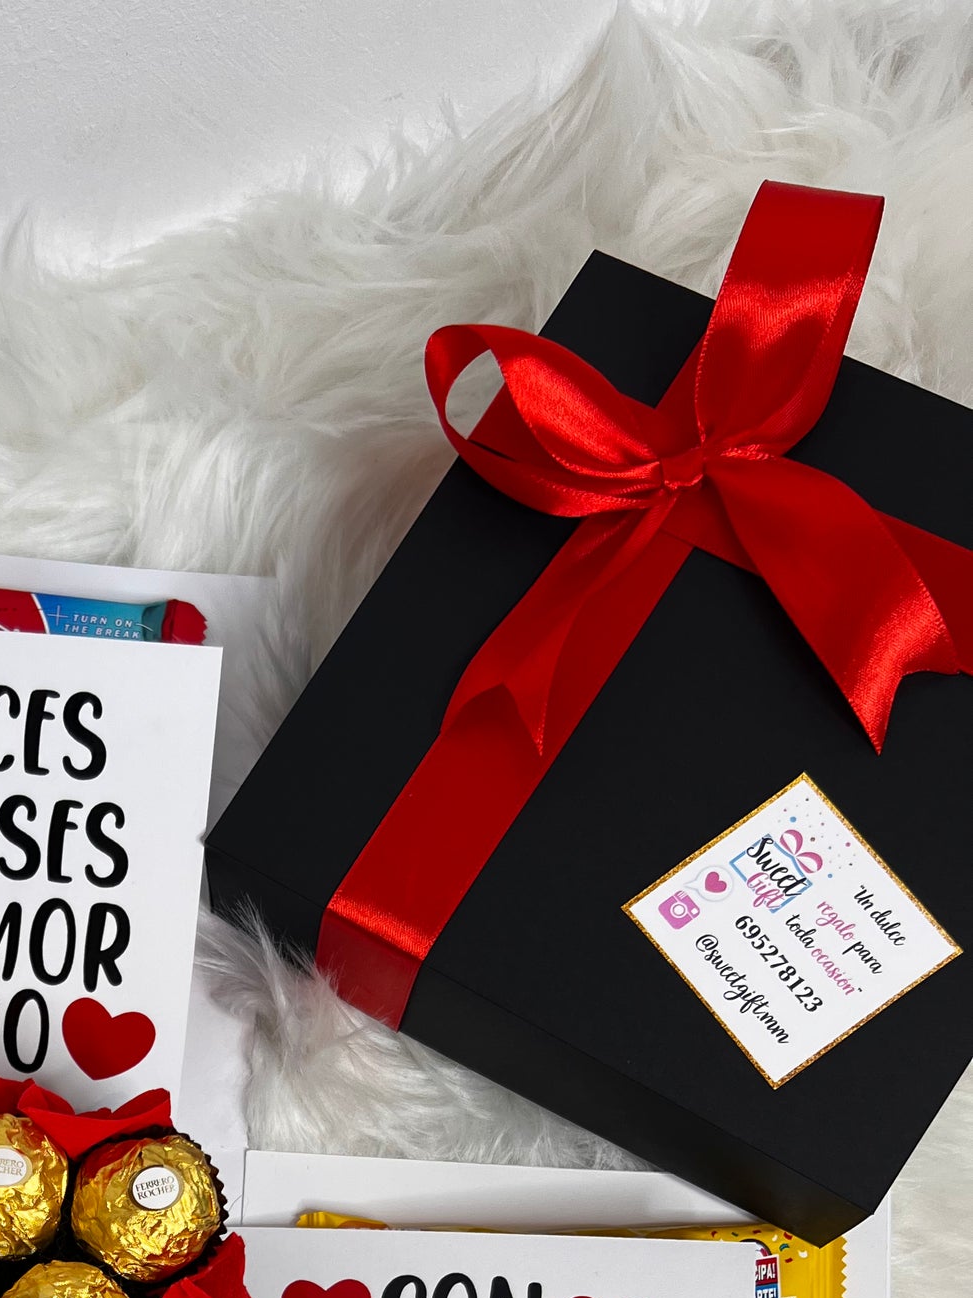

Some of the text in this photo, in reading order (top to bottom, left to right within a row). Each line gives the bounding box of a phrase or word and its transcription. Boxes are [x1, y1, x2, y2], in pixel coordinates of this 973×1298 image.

[64, 624, 140, 639] THE BREAK
[73, 614, 133, 628] TURN ON
[746, 837, 807, 897] Sweet
[746, 872, 785, 908] Gift
[785, 914, 817, 949] toda
[815, 901, 883, 974] regalo para
[870, 910, 907, 946] dulce
[735, 915, 823, 1012] 695278123
[695, 934, 789, 1044] @sweetgift.mm
[135, 1176, 175, 1192] FERRERO
[137, 1184, 176, 1200] ROCHER
